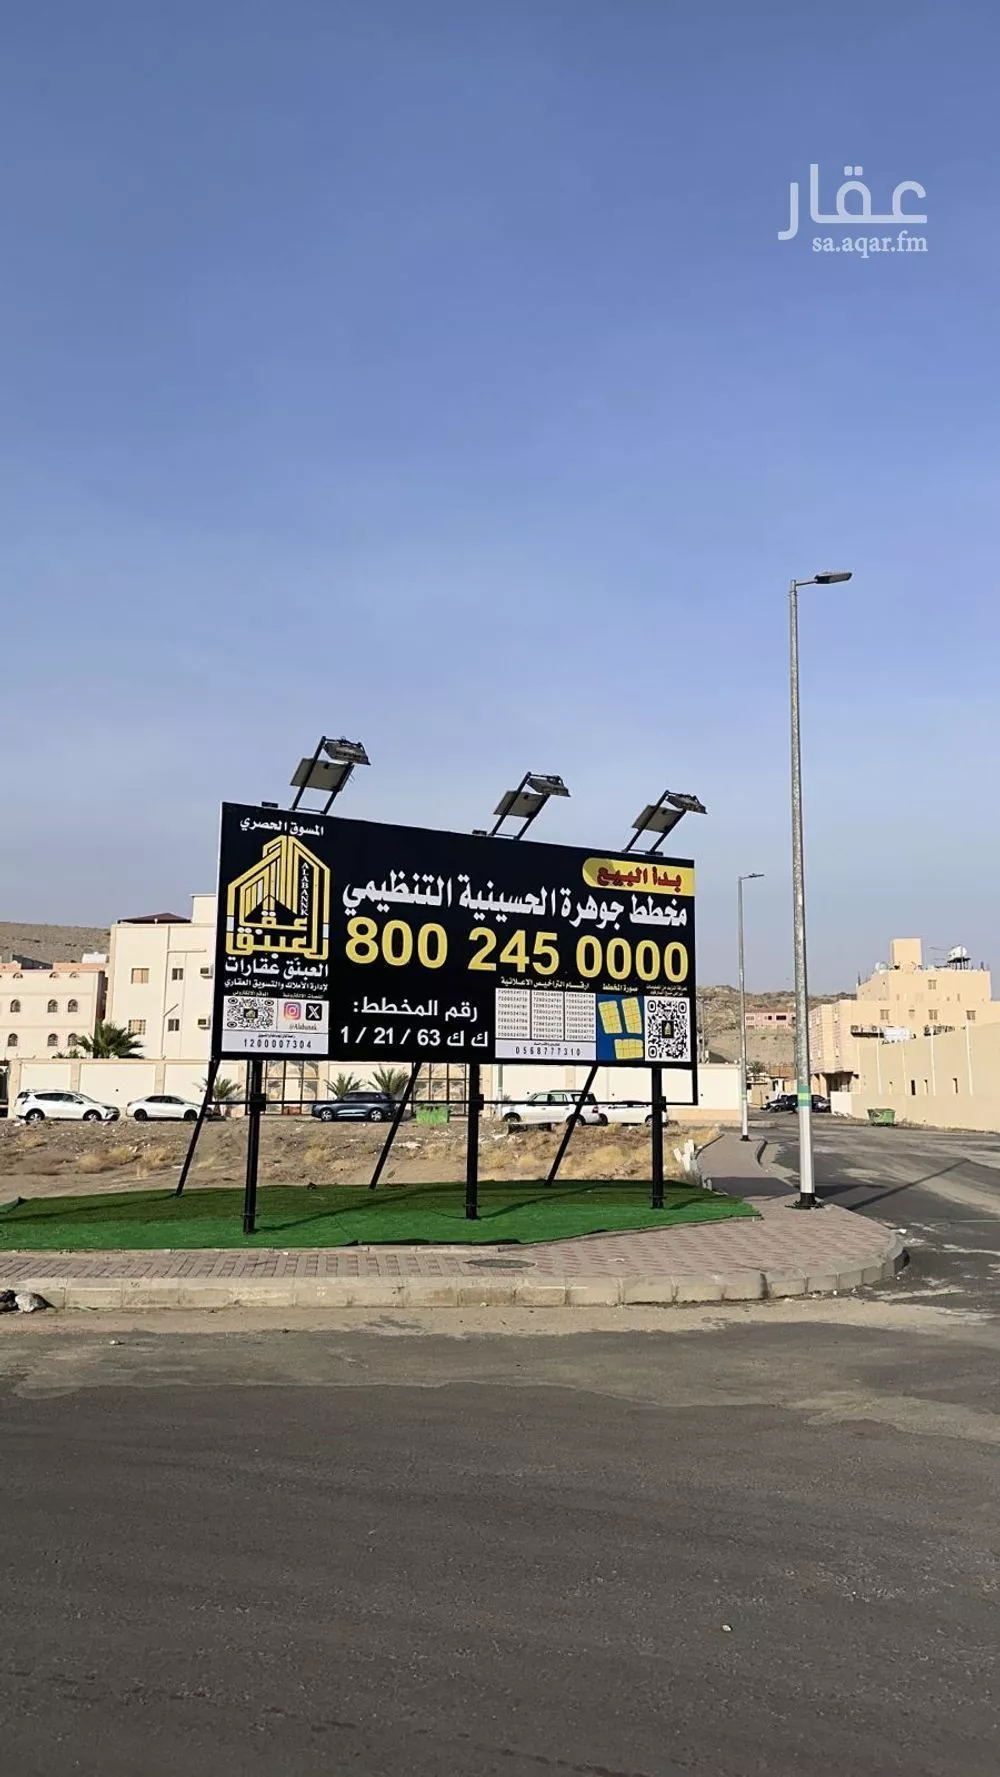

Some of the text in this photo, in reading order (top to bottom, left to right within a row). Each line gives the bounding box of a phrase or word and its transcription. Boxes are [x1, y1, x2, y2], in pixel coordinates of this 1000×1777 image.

[239, 817, 288, 831] الحصري
[300, 861, 310, 916] ALABANNK
[596, 866, 682, 892] بدأ البيع
[342, 869, 688, 930] مخطط جوهرة الحسينية التنظيمي
[345, 916, 689, 983] 800 245 0000
[224, 956, 280, 976] عقارات
[224, 978, 252, 988] العقاري
[252, 980, 284, 990] والتسويق
[353, 996, 438, 1017] المخطط:
[445, 1001, 478, 1022] رقم
[340, 1025, 489, 1047] ك ك 63 / 21 / 1
